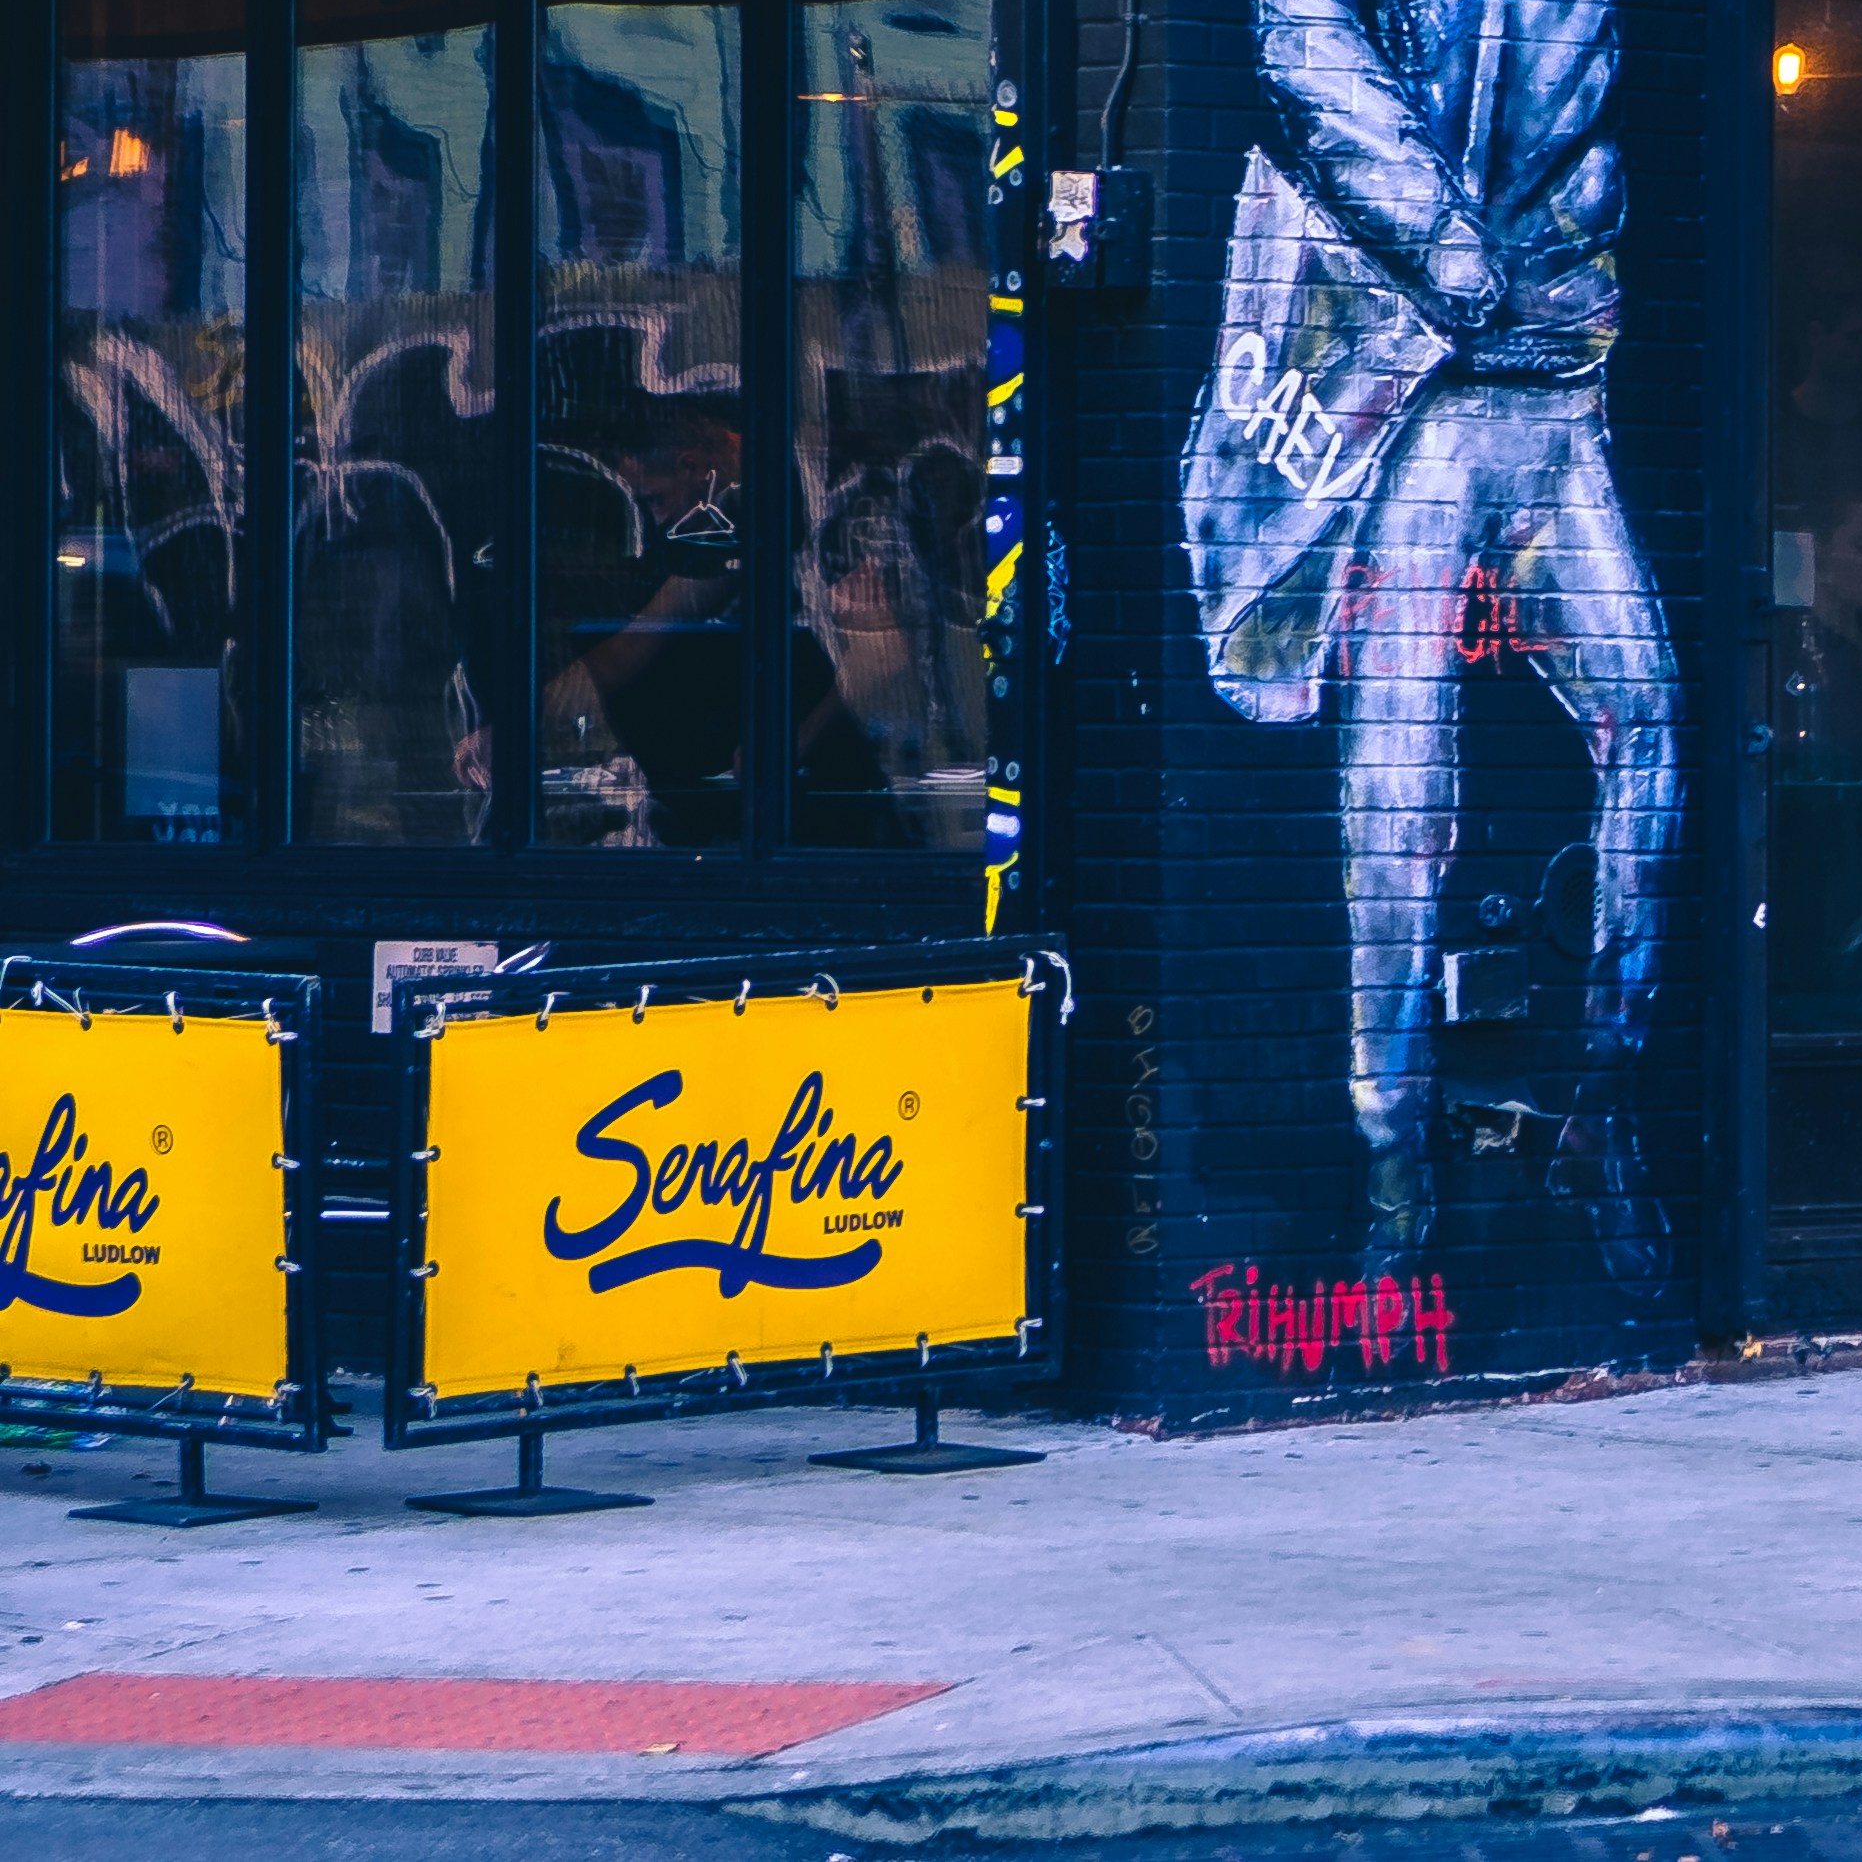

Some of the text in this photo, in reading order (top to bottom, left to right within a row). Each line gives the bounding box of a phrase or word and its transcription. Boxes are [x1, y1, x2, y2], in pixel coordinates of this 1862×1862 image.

[544, 1069, 904, 1268] Serafina
[823, 1209, 904, 1235] LUDLOW
[82, 1242, 161, 1265] LUDLOW
